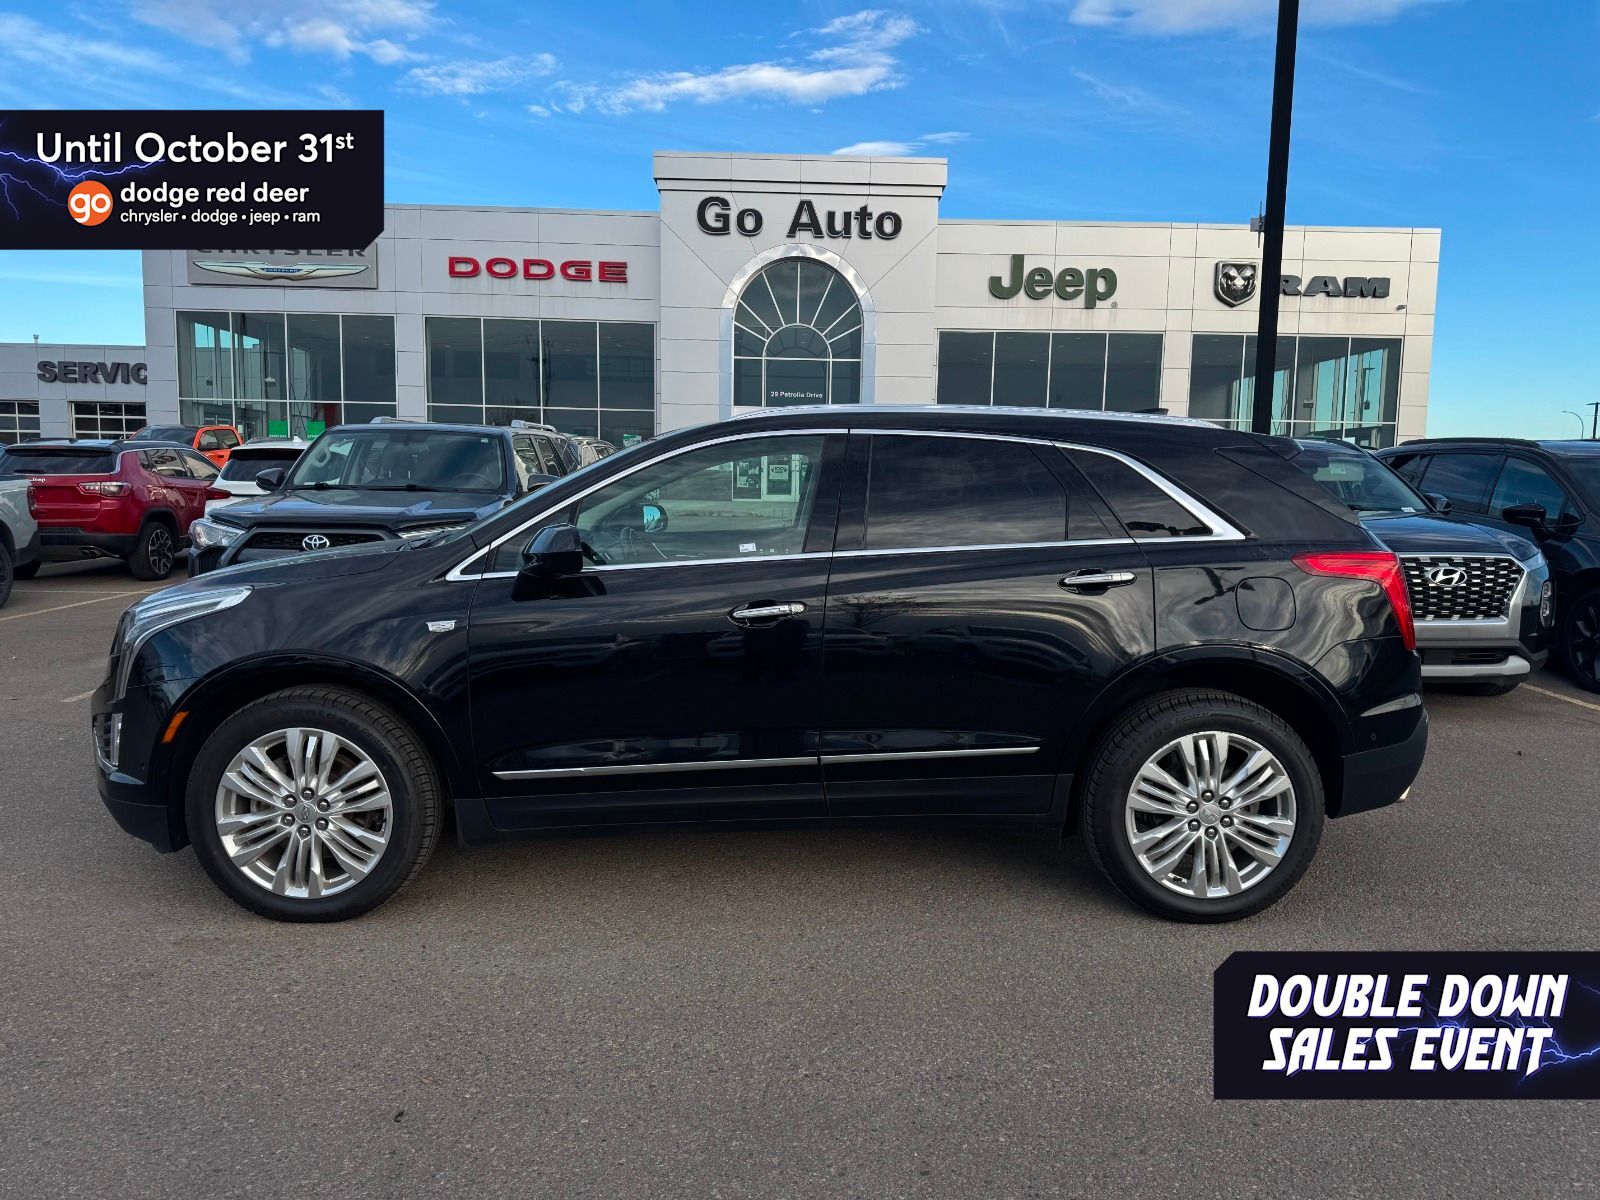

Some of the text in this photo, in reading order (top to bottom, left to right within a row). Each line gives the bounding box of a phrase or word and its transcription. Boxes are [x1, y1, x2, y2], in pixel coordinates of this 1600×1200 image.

[697, 196, 902, 240] Go Auto
[448, 256, 628, 283] DODGE
[989, 254, 1118, 309] Jeep
[1280, 274, 1391, 298] RAM
[37, 360, 148, 385] SERVIC
